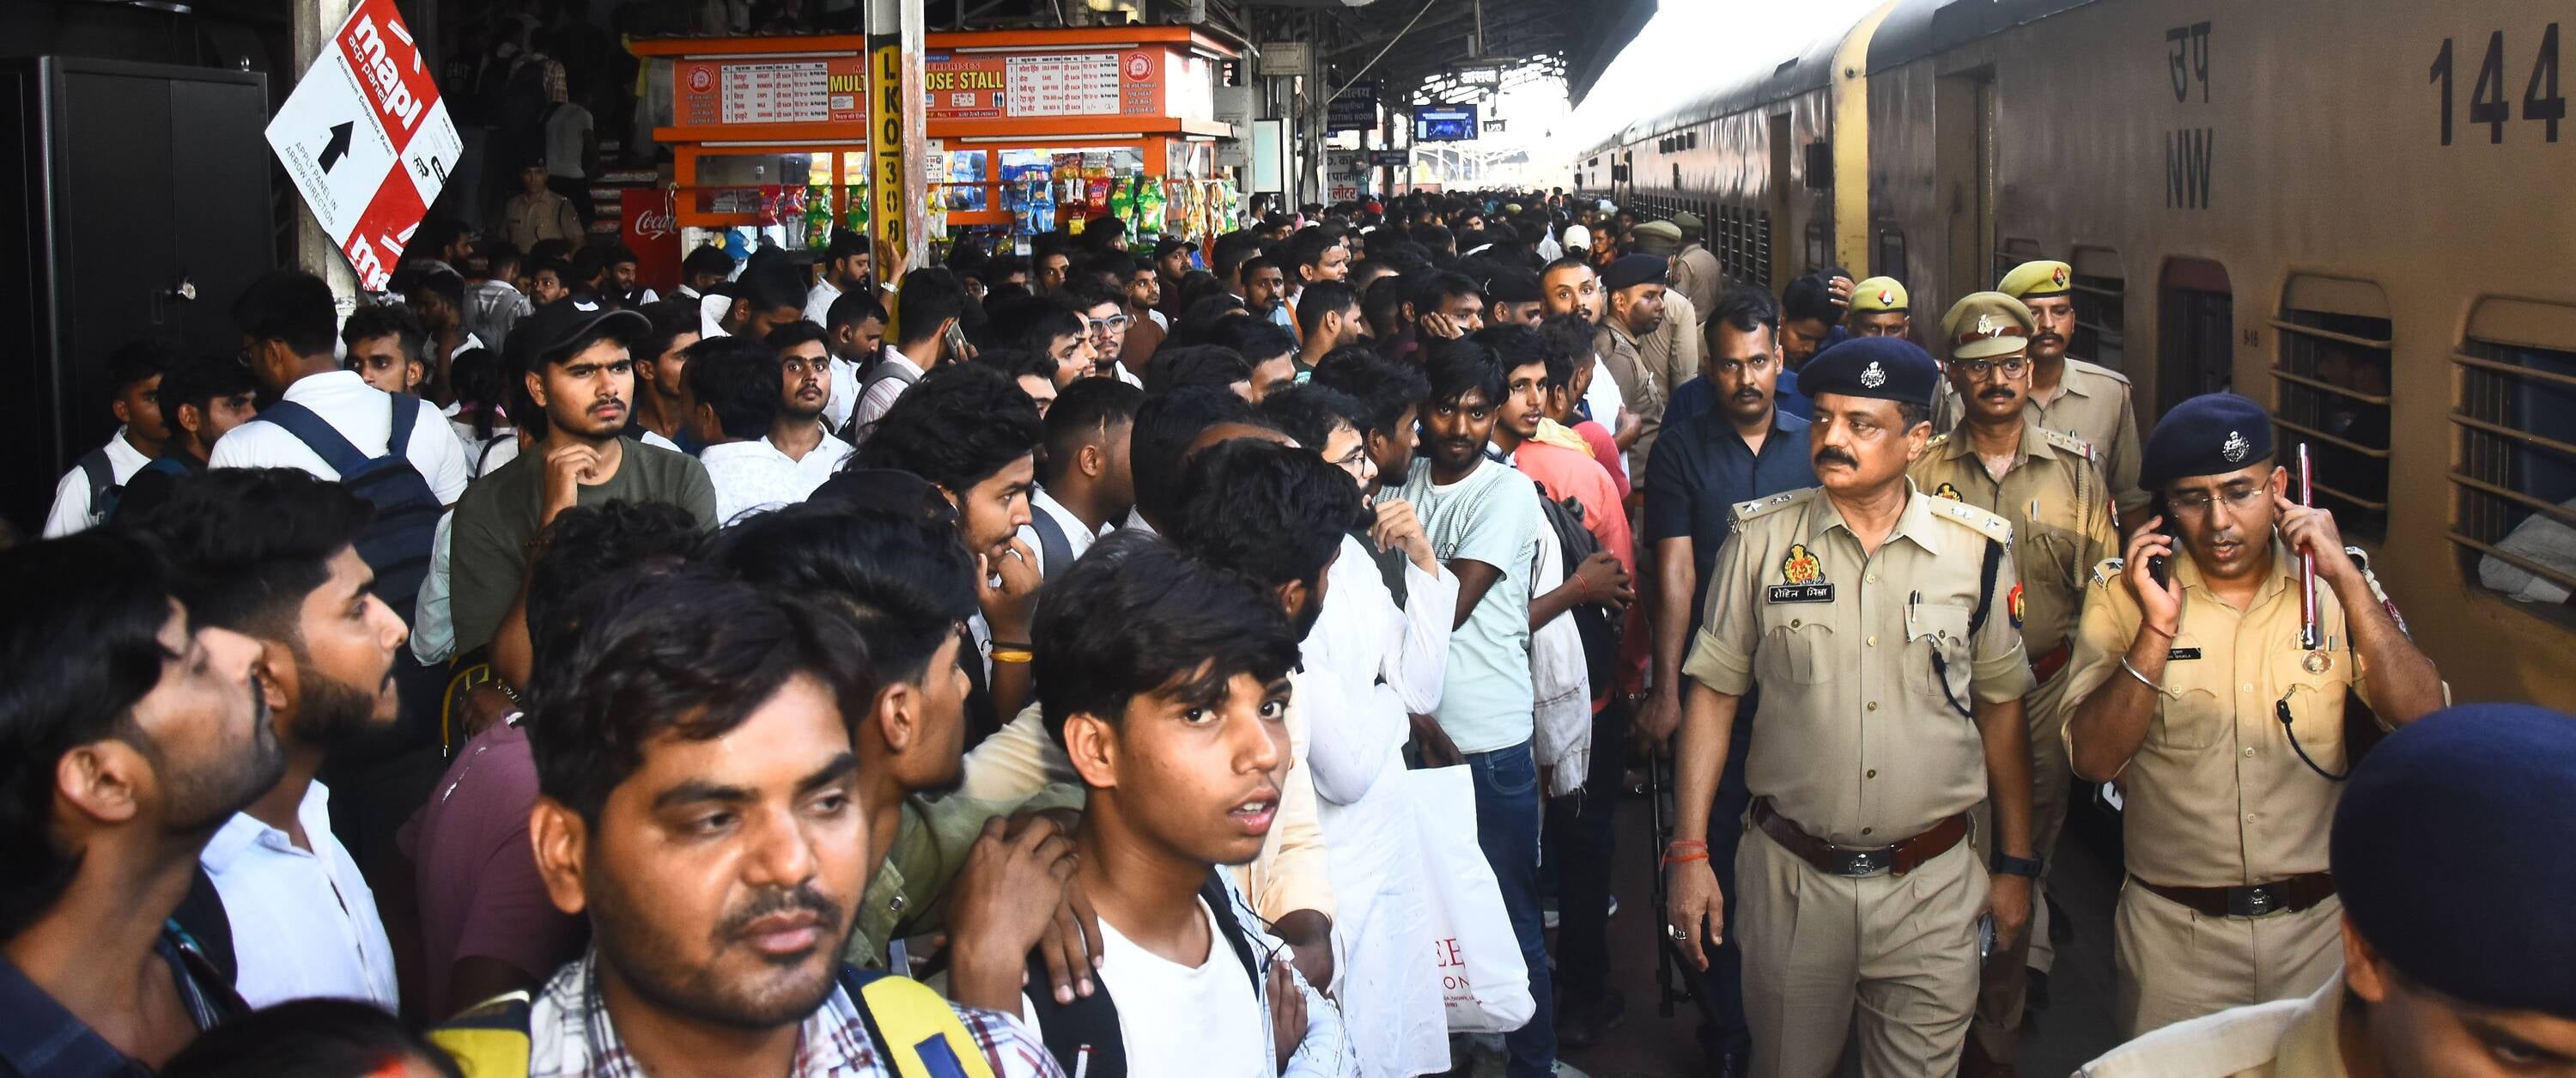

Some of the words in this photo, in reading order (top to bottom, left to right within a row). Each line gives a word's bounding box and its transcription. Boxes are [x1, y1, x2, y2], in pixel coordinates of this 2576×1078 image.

[348, 36, 364, 63] acp
[361, 61, 388, 106] panel
[354, 14, 422, 131] mapl
[829, 75, 866, 92] MULT
[926, 72, 954, 90] OSE
[959, 71, 1005, 89] STALL
[2166, 21, 2212, 104] उप
[2429, 22, 2566, 146] 144
[284, 145, 307, 179] ARROW
[305, 177, 335, 227] DIRECTION
[295, 141, 315, 171] APPLY
[312, 167, 332, 202] PANEL
[1332, 184, 1357, 200] लीटर
[2166, 127, 2213, 210] NW
